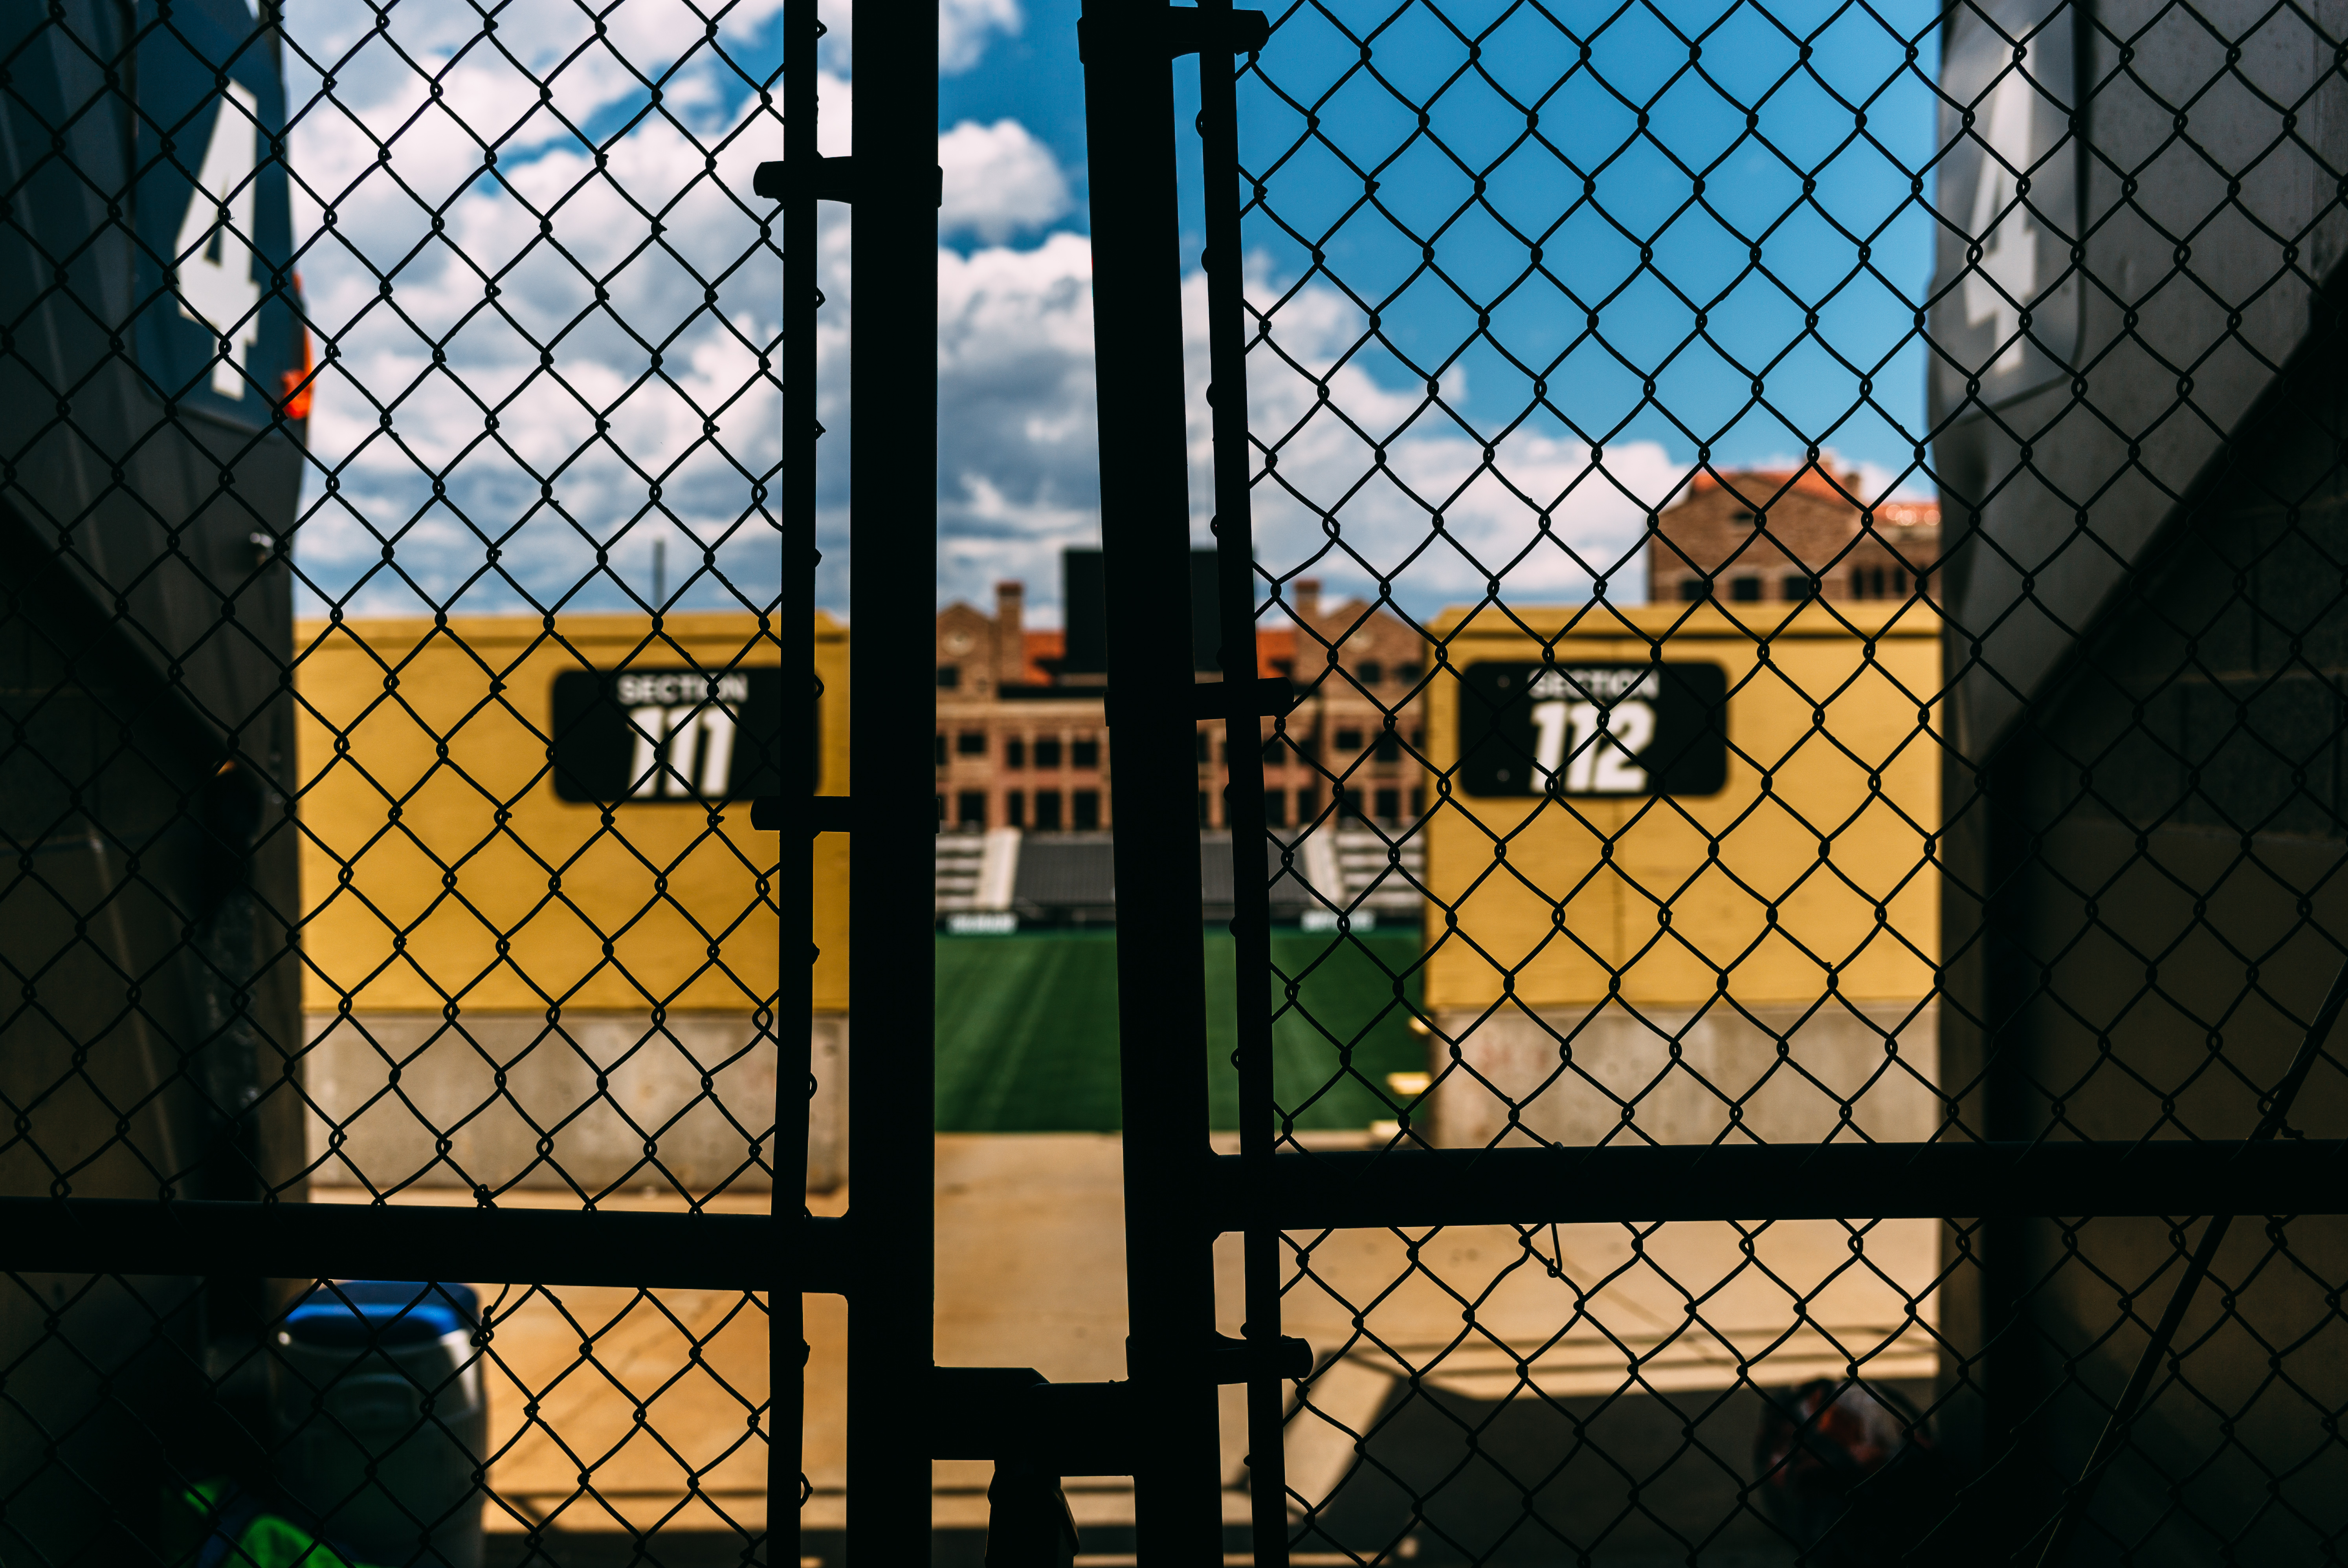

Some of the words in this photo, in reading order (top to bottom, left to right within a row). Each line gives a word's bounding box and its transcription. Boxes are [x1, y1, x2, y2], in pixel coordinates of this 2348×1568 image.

[174, 77, 262, 401] 4
[1965, 24, 2037, 374] 4
[1528, 668, 1660, 700] SECTION
[627, 706, 738, 797] 111
[1530, 700, 1656, 793] 112
